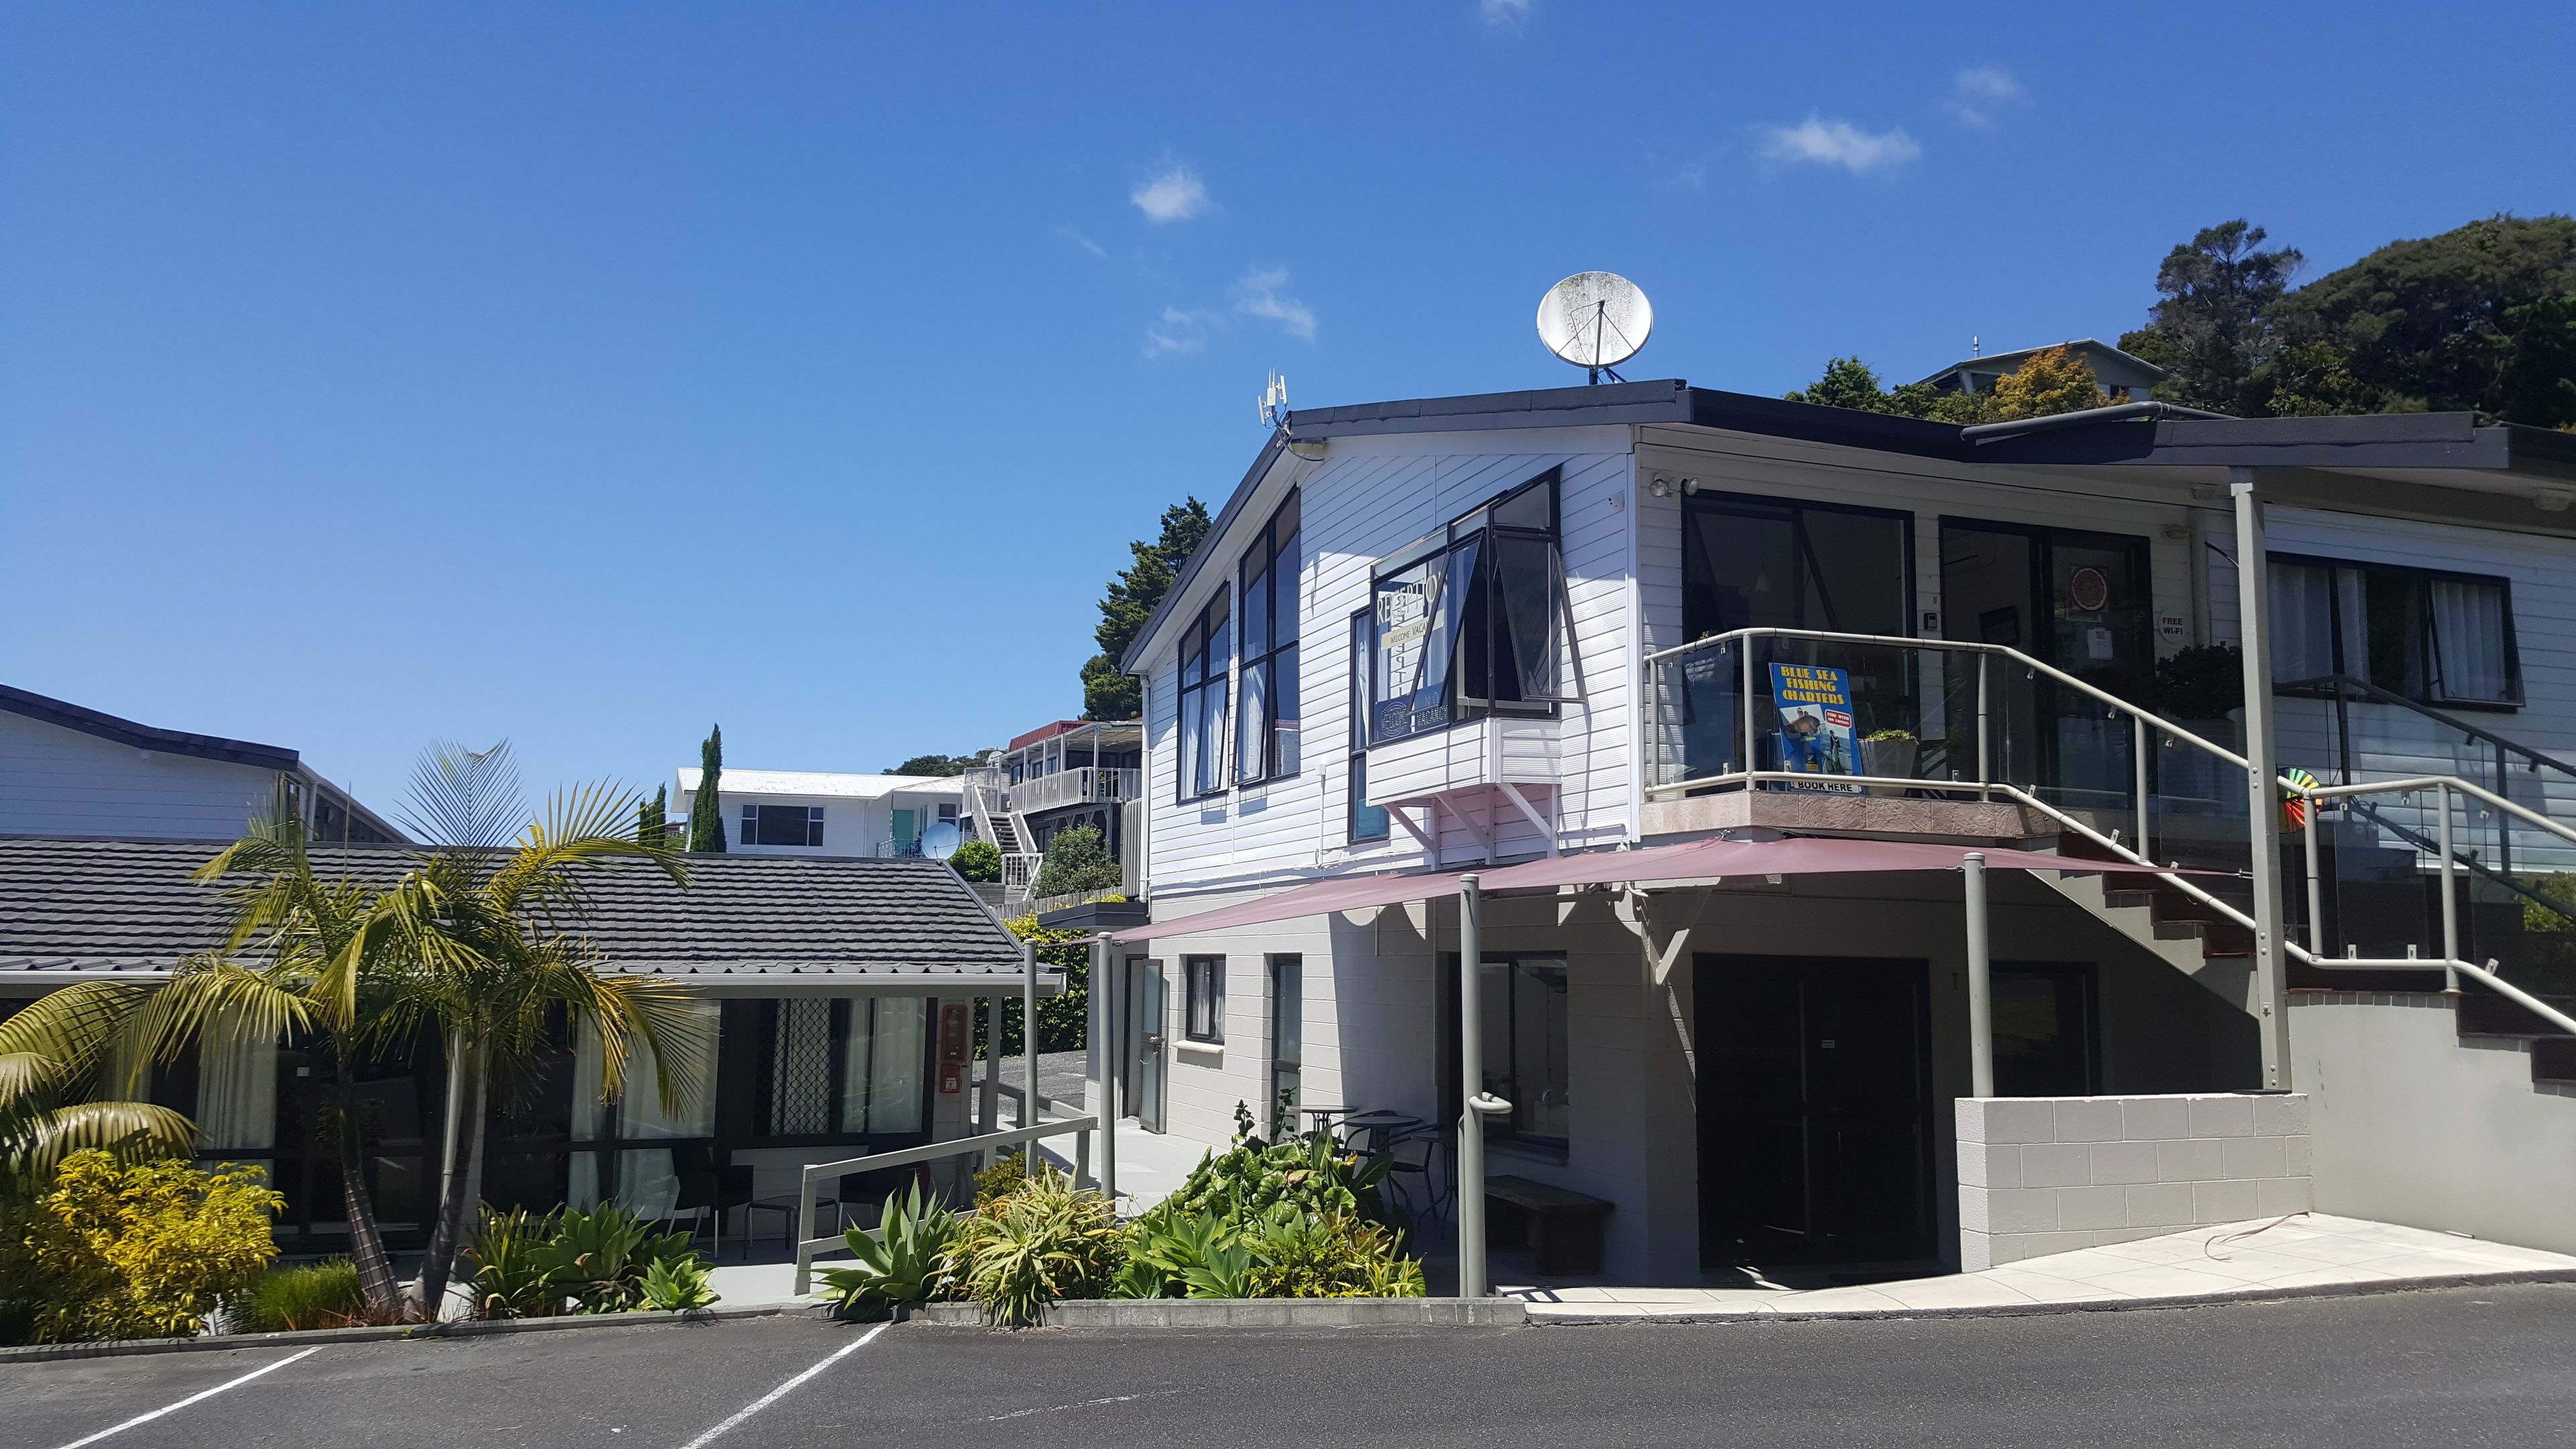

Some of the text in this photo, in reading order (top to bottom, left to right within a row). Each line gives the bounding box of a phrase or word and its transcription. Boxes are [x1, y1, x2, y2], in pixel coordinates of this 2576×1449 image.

[2162, 617, 2183, 625] FREE
[1390, 631, 1410, 644] WELCOME
[1781, 666, 1838, 681] BLUE SEA
[1786, 678, 1836, 692] FISHING
[1782, 690, 1844, 704] CHARTERS
[1798, 781, 1853, 792] BOOK HERE
